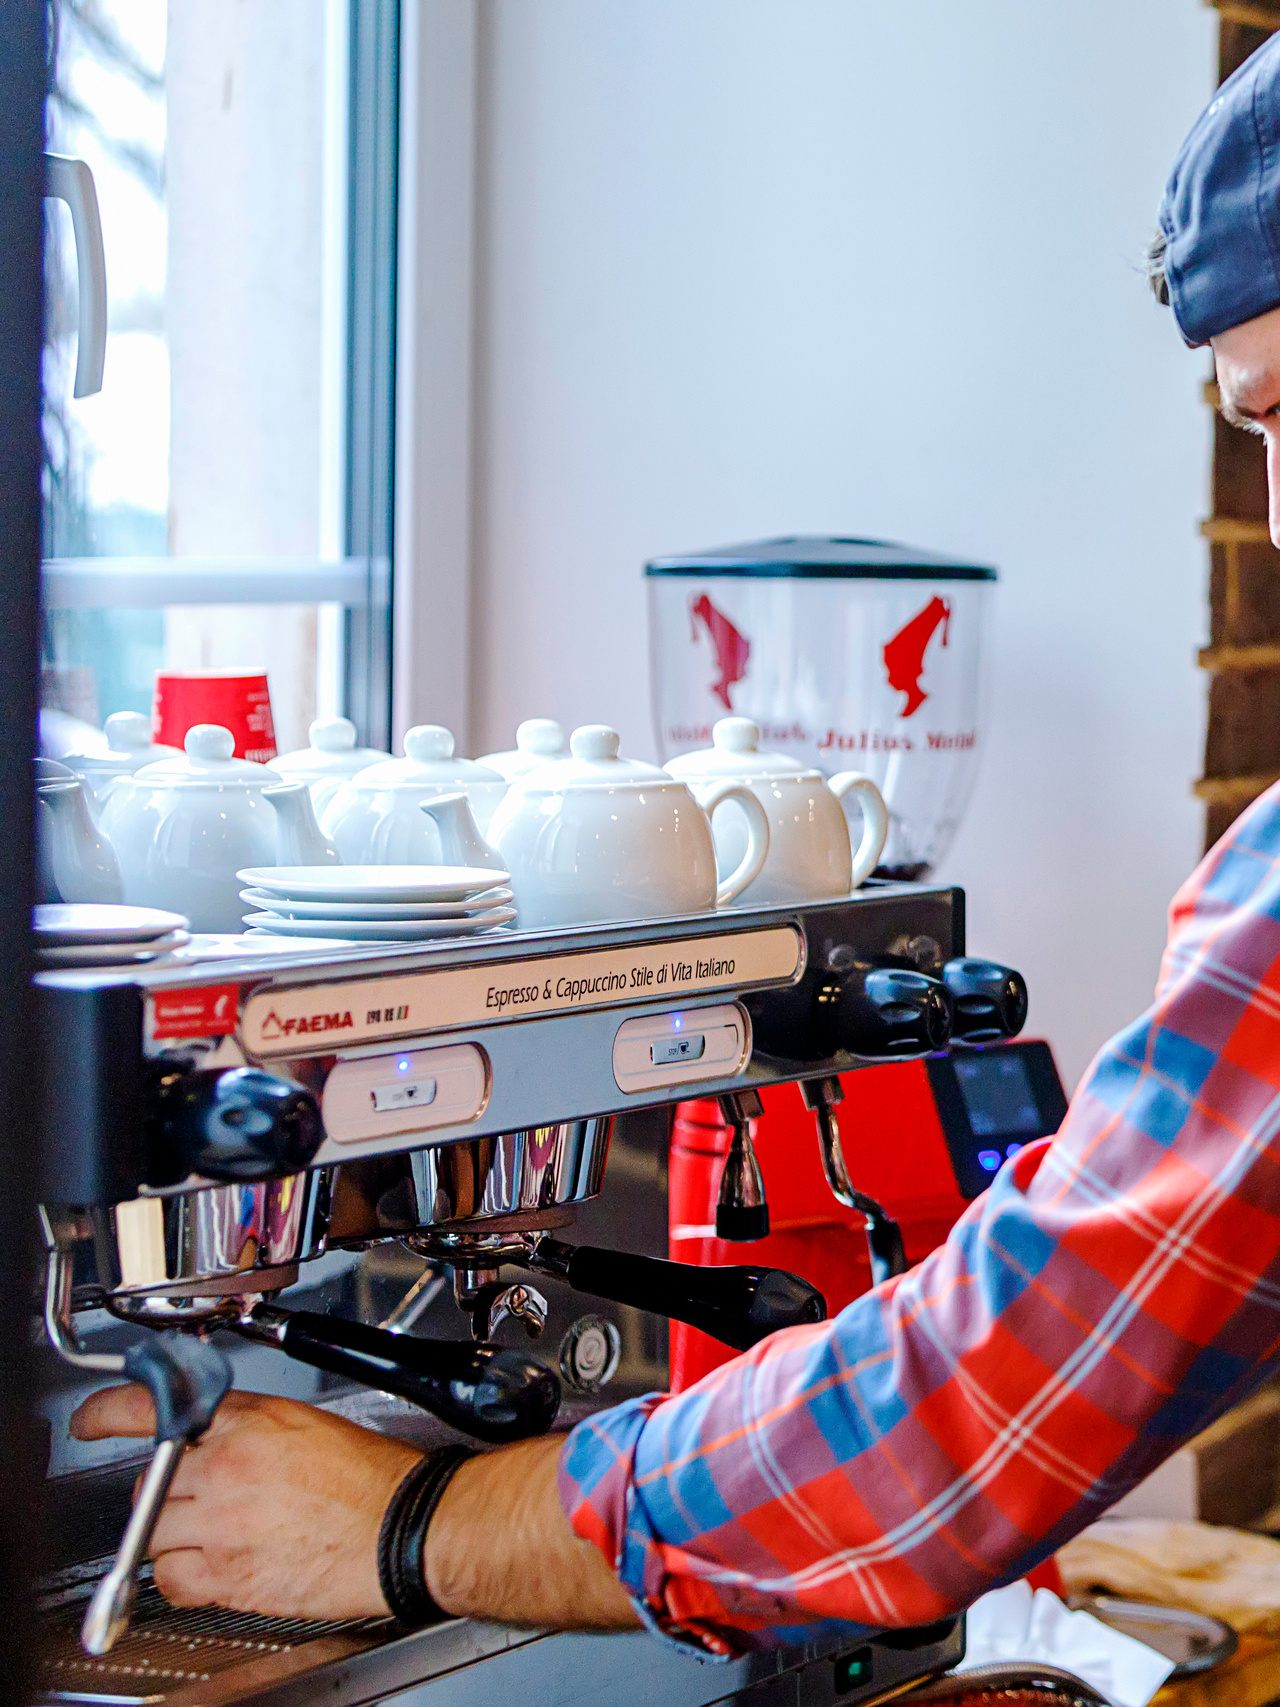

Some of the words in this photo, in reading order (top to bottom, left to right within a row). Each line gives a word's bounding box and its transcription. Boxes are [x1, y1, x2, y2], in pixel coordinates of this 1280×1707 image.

[817, 729, 913, 751] Julius
[486, 986, 539, 1012] Espresso
[542, 979, 552, 1000] &
[556, 971, 627, 1001] Cappuccino
[629, 966, 654, 988] Stile
[656, 963, 669, 985] di
[671, 961, 692, 982] Vita
[695, 957, 736, 979] Italiano
[281, 1011, 354, 1036] FAEMA
